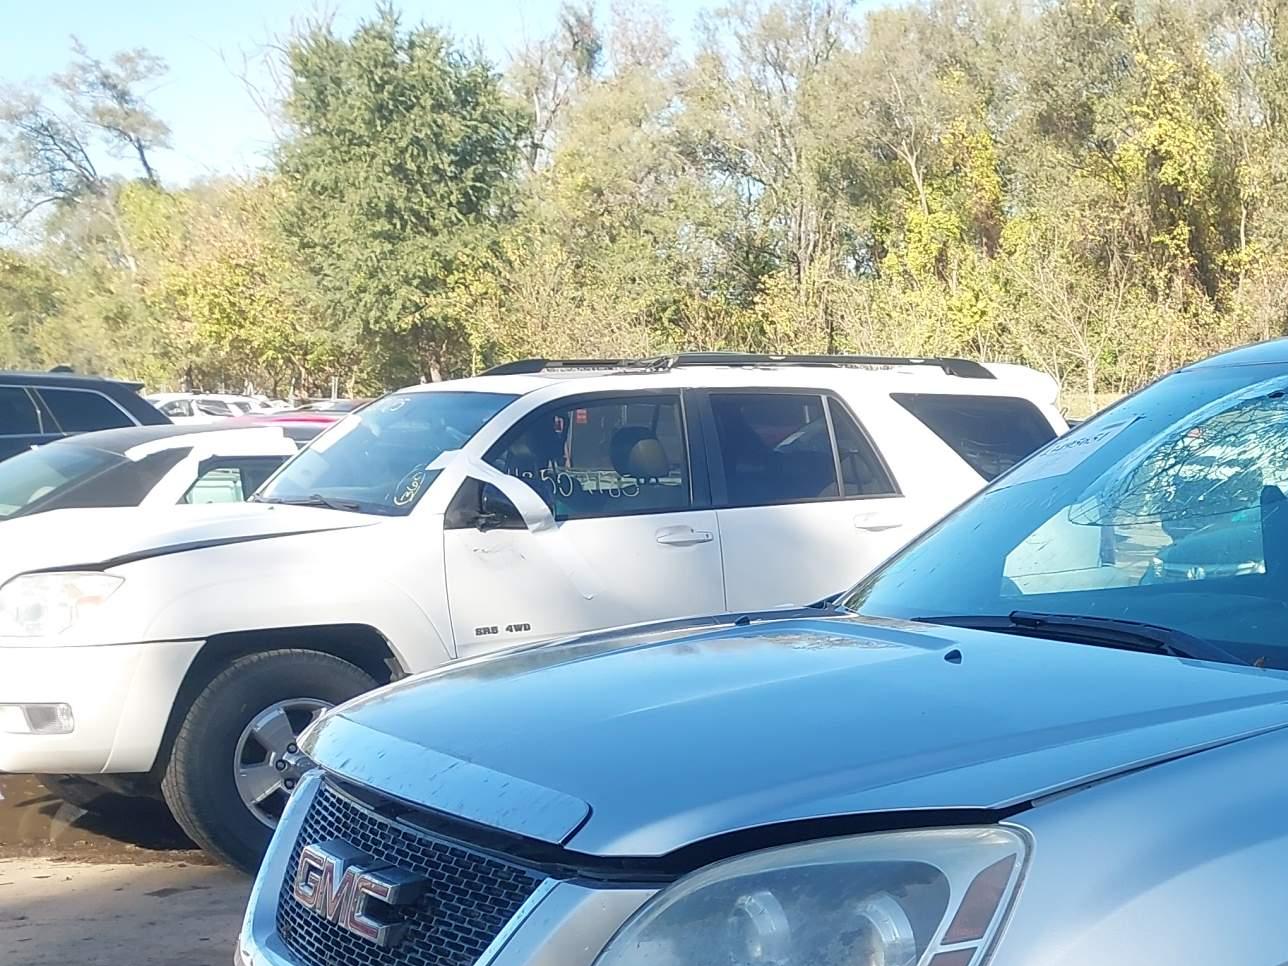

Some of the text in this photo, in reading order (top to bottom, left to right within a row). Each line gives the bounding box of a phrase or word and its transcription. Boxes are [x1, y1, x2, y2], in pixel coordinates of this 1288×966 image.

[475, 623, 531, 636] SR5 4WD
[293, 842, 398, 947] GMC
